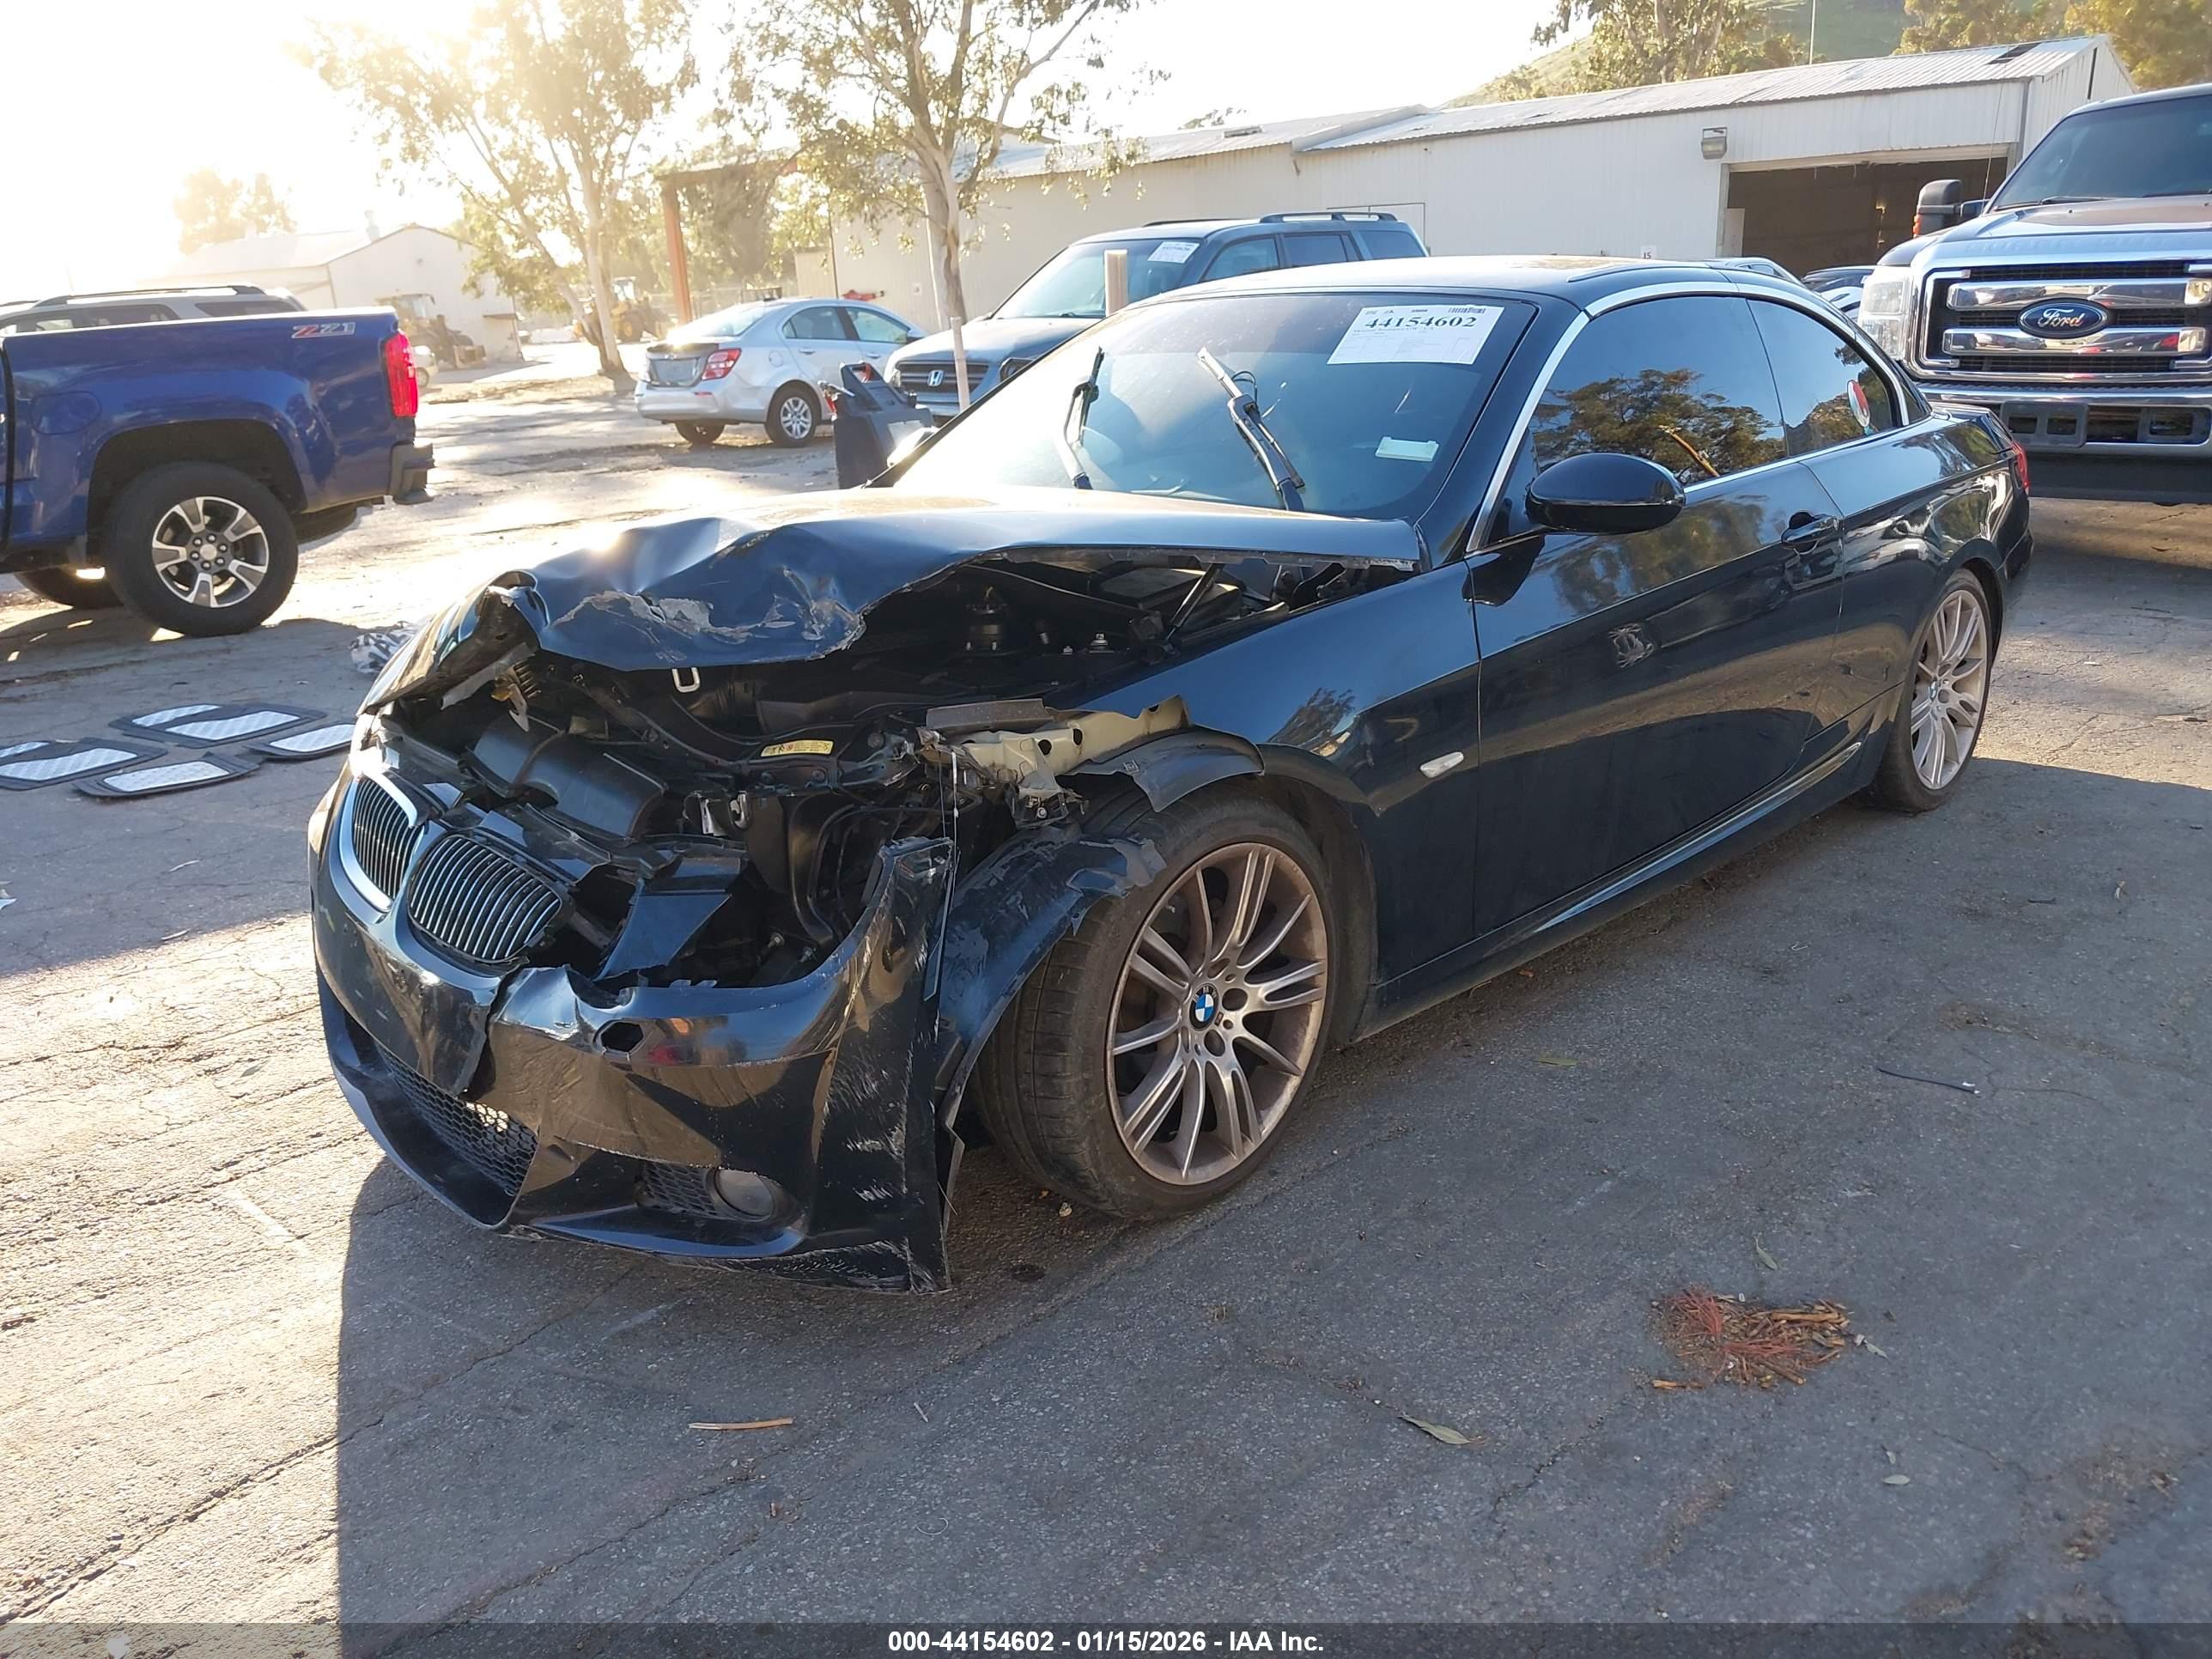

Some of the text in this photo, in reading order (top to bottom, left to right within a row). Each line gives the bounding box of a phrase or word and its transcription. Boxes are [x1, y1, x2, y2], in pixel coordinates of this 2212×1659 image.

[1364, 316, 1477, 328] 44154602
[2037, 308, 2086, 327] Ford
[291, 322, 356, 339] Z71
[1194, 986, 1217, 1003] BMW
